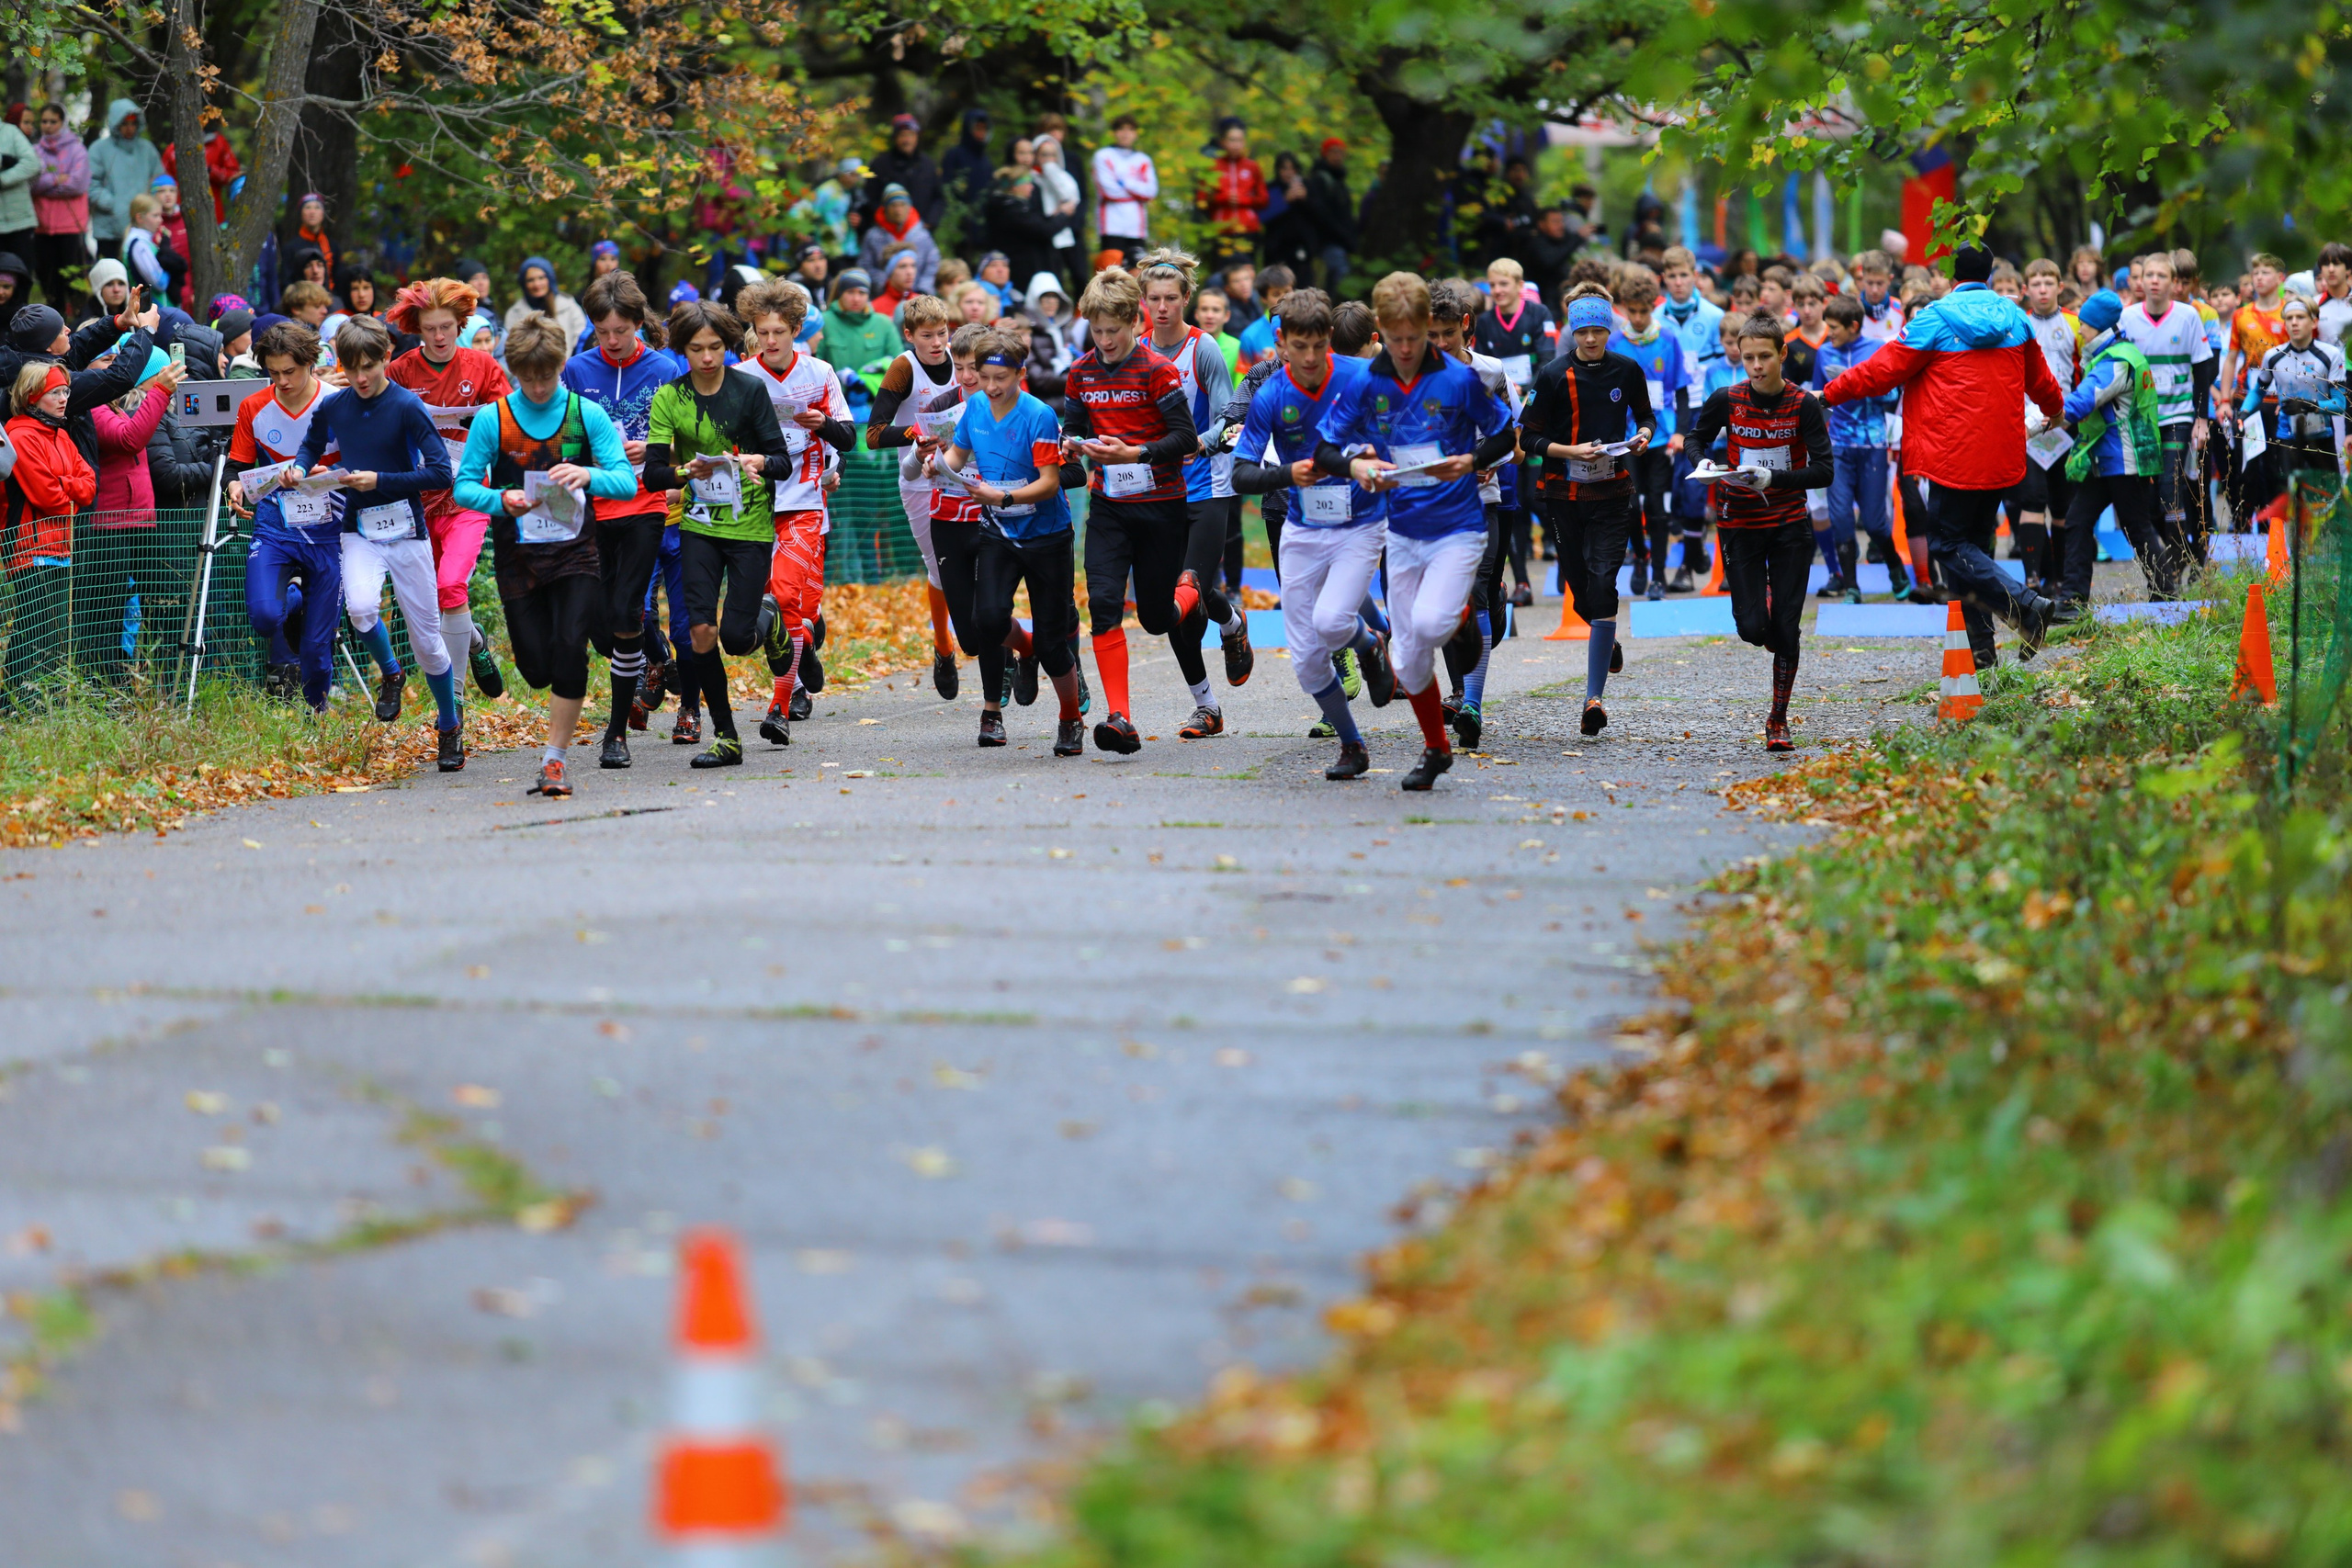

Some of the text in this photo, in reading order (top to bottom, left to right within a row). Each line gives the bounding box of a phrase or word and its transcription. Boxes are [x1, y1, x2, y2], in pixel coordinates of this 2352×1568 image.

[1112, 390, 1148, 402] WEST
[1732, 423, 1797, 439] NORD WEST
[808, 450, 820, 479] think
[1581, 463, 1598, 473] 204
[1757, 459, 1774, 468] 203
[1117, 470, 1135, 482] 208
[705, 481, 722, 491] 214
[296, 503, 313, 513] 223
[1316, 500, 1334, 510] 202
[376, 517, 395, 530] 224
[1776, 684, 1784, 712] NORD
